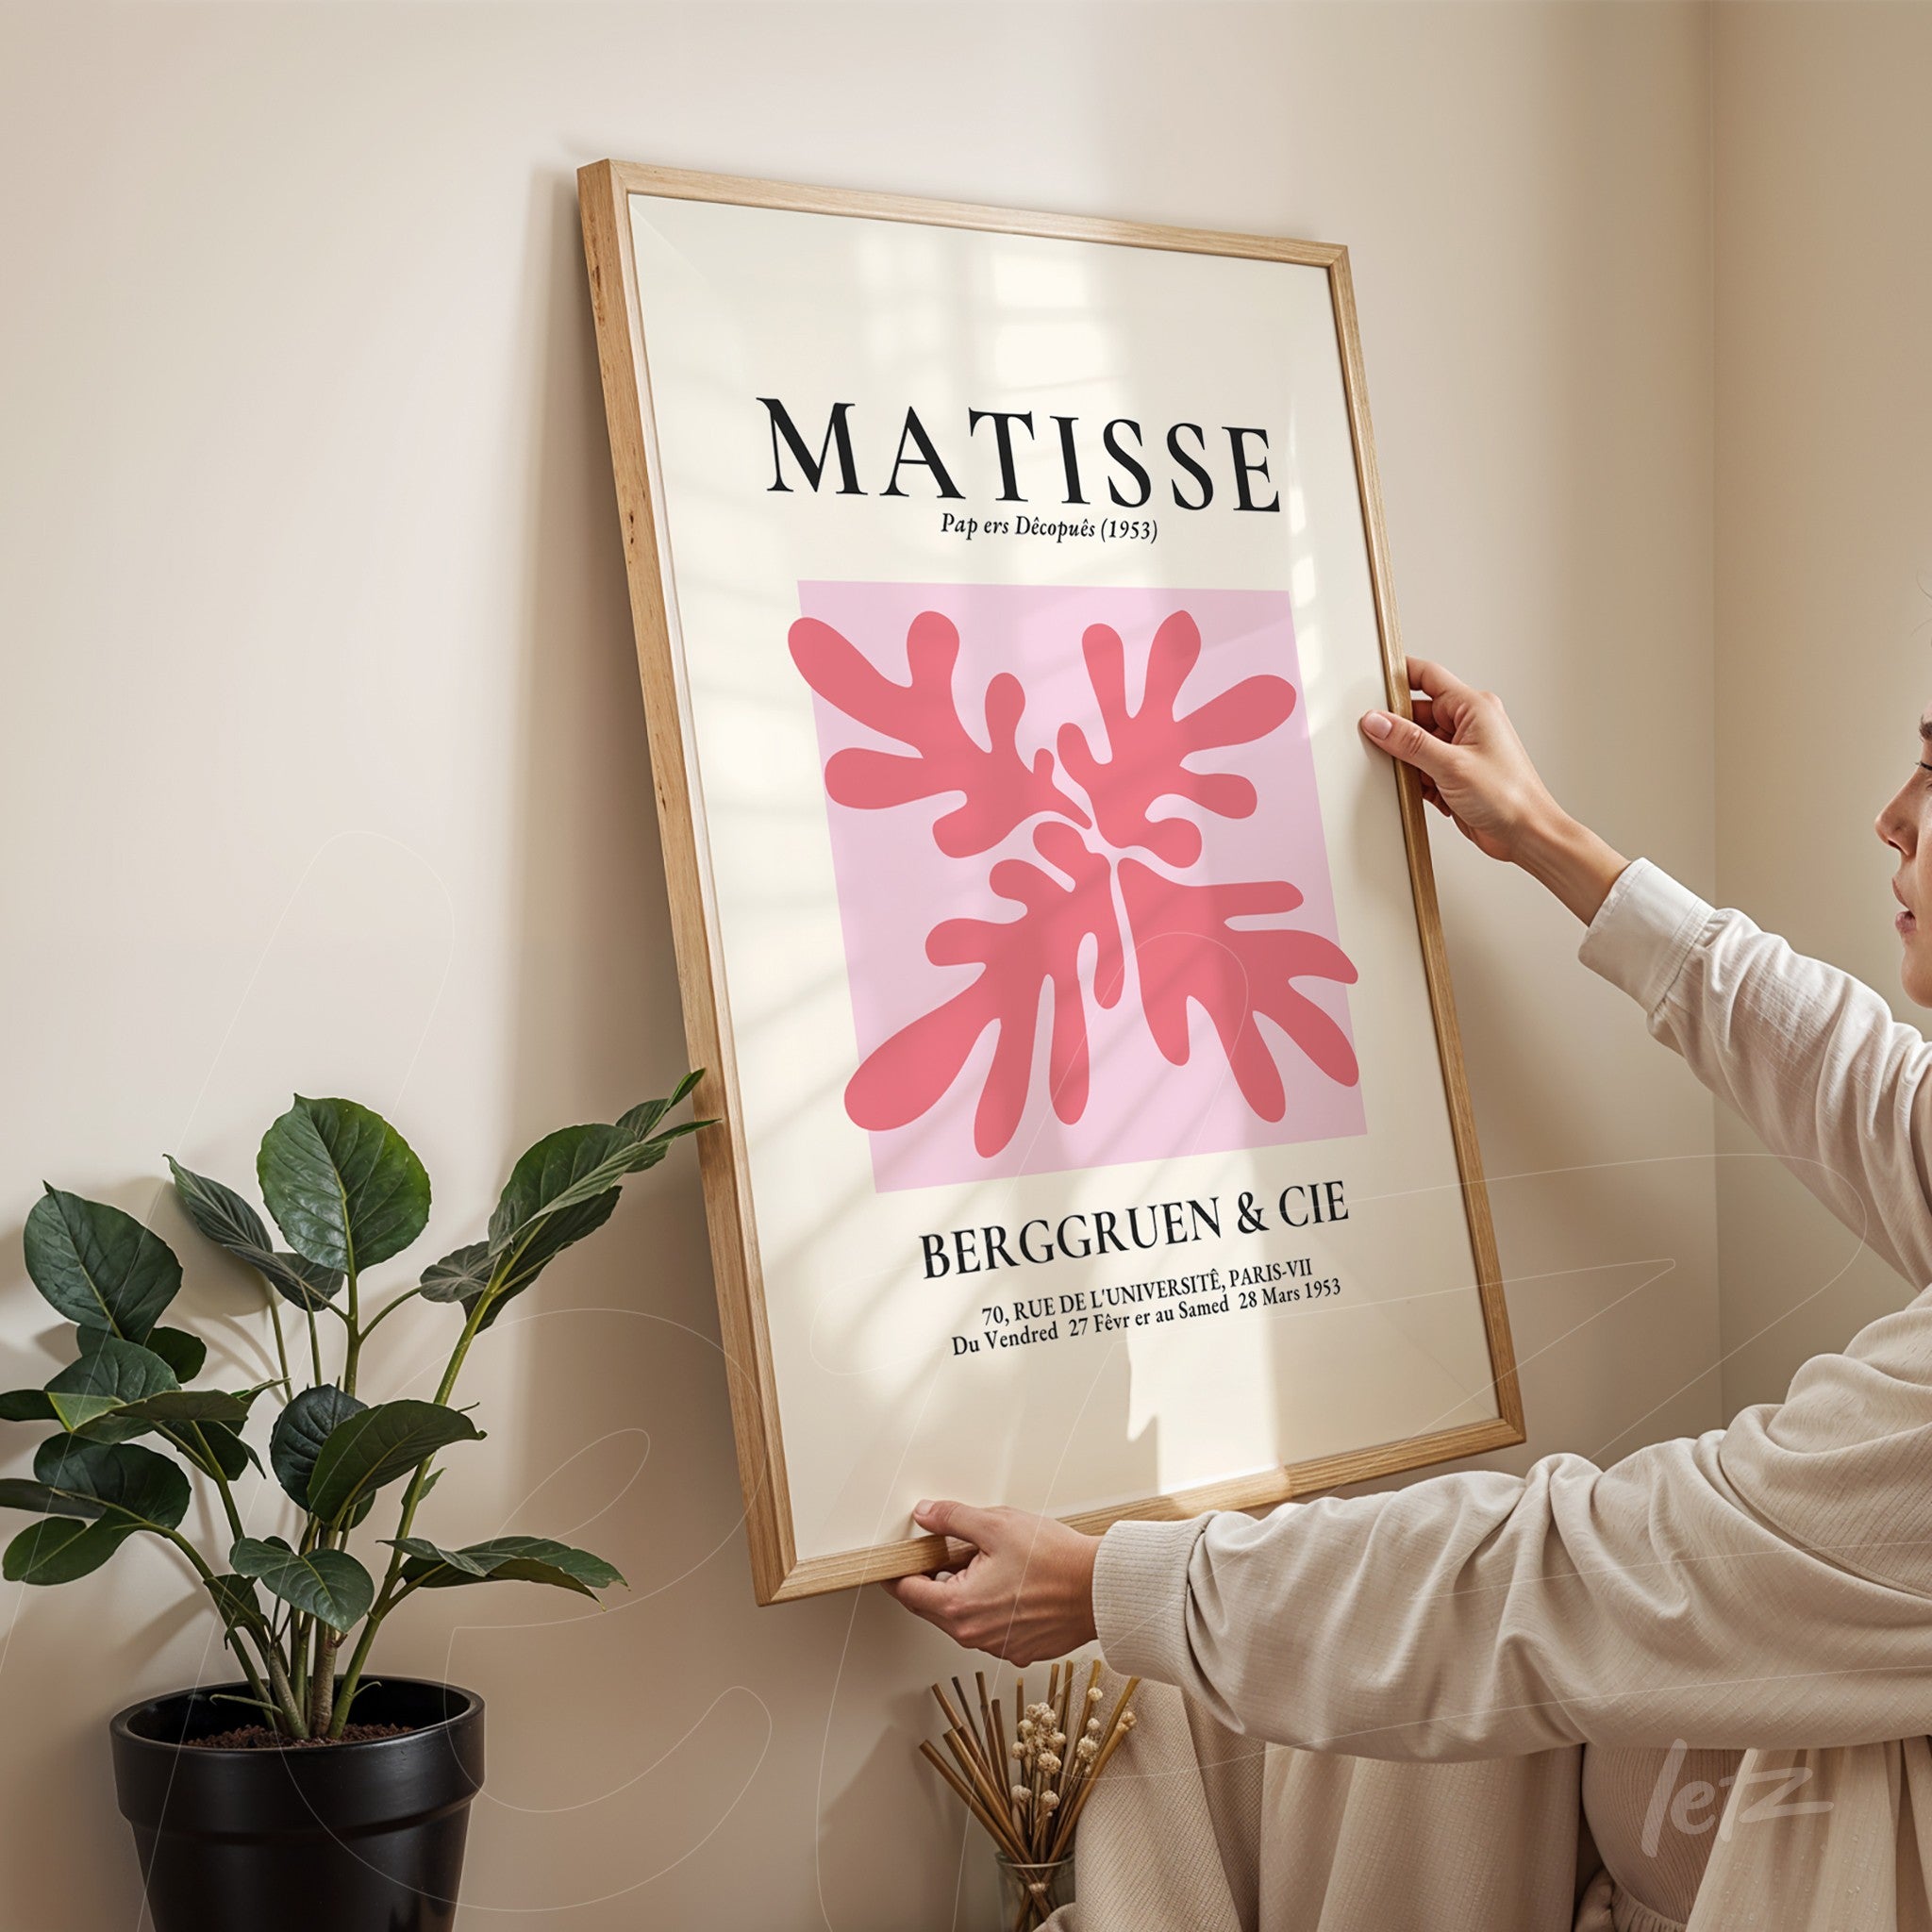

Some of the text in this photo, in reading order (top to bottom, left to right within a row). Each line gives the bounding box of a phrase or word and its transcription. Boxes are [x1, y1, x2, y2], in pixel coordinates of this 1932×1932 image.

[756, 397, 1281, 513] MATISSE
[941, 512, 978, 541] Pap
[983, 521, 1009, 535] ers
[1100, 518, 1158, 544] (1953)
[920, 1179, 1350, 1280] BERGGRUEN & CIE
[951, 1277, 1341, 1356] Du Vendred 27 Fêvr er au Samed 28 Mars 1953
[981, 1306, 1010, 1326] 70,
[1013, 1296, 1057, 1322] RUE
[1058, 1291, 1088, 1315] DE
[1228, 1257, 1313, 1289] PARIS-VII
